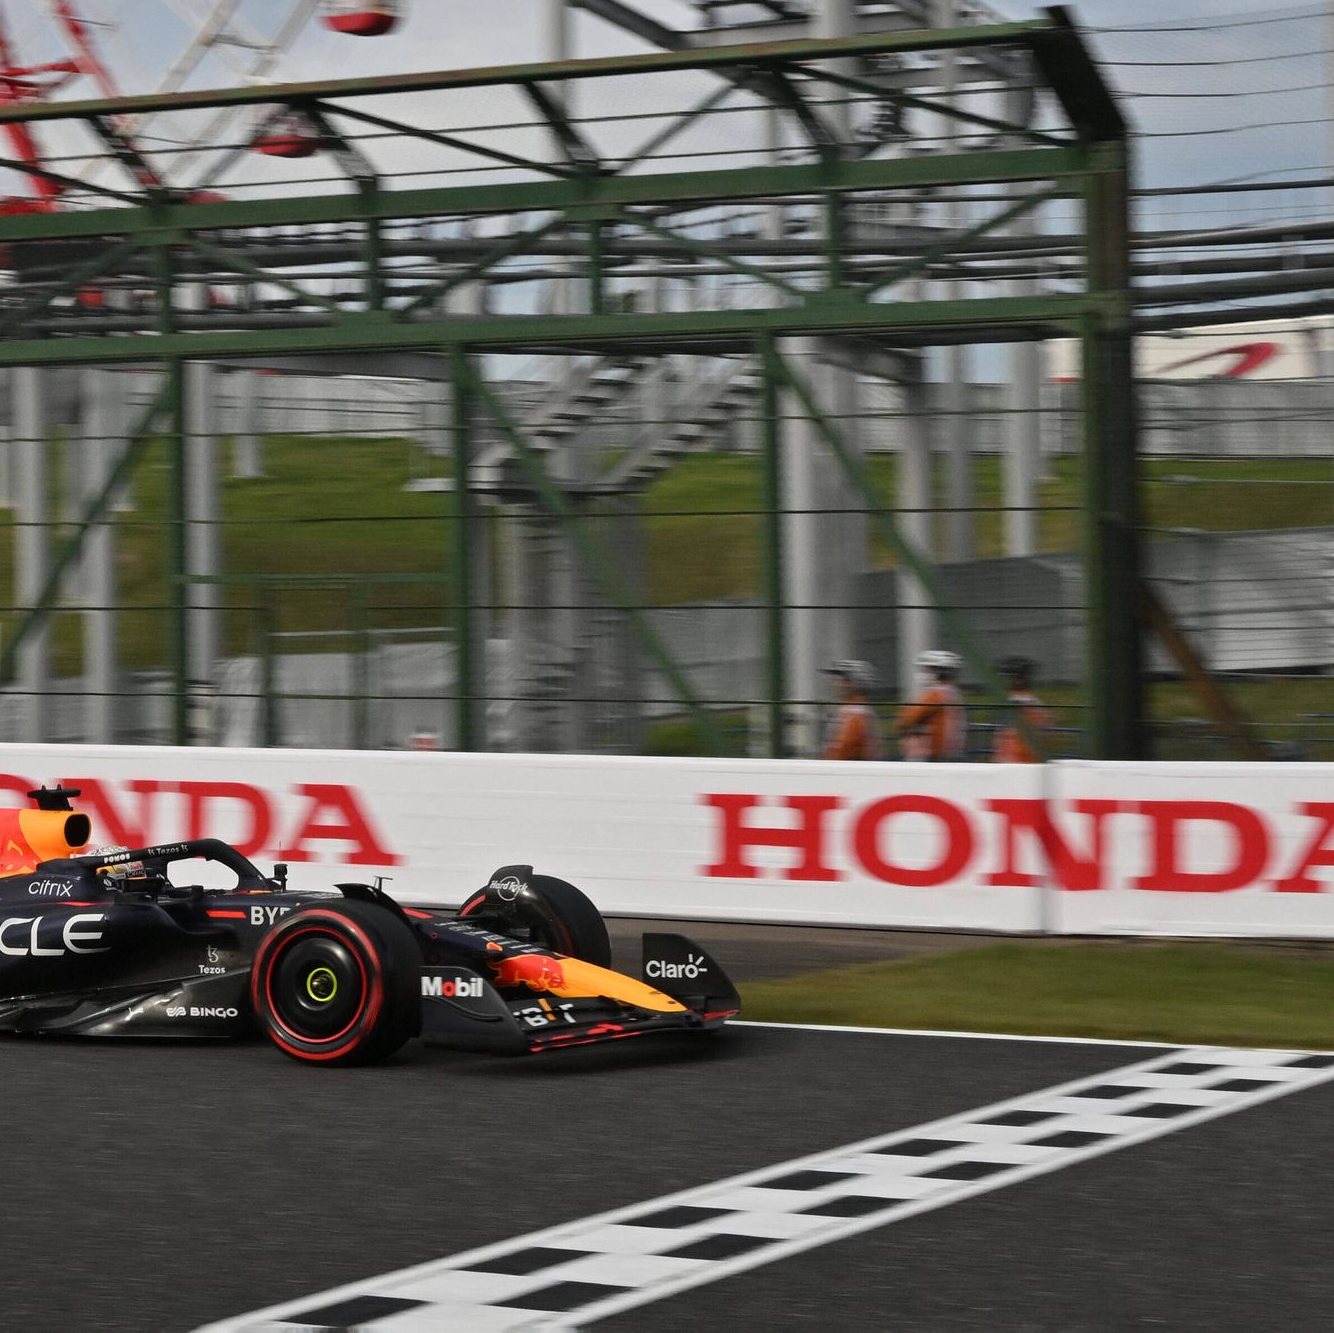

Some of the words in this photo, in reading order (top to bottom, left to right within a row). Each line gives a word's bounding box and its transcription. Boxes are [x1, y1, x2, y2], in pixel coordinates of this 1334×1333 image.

[28, 880, 73, 897] citrix
[198, 965, 226, 974] Tezos
[646, 958, 700, 978] Claro
[420, 976, 484, 997] Mobil
[190, 1007, 238, 1018] BINGO
